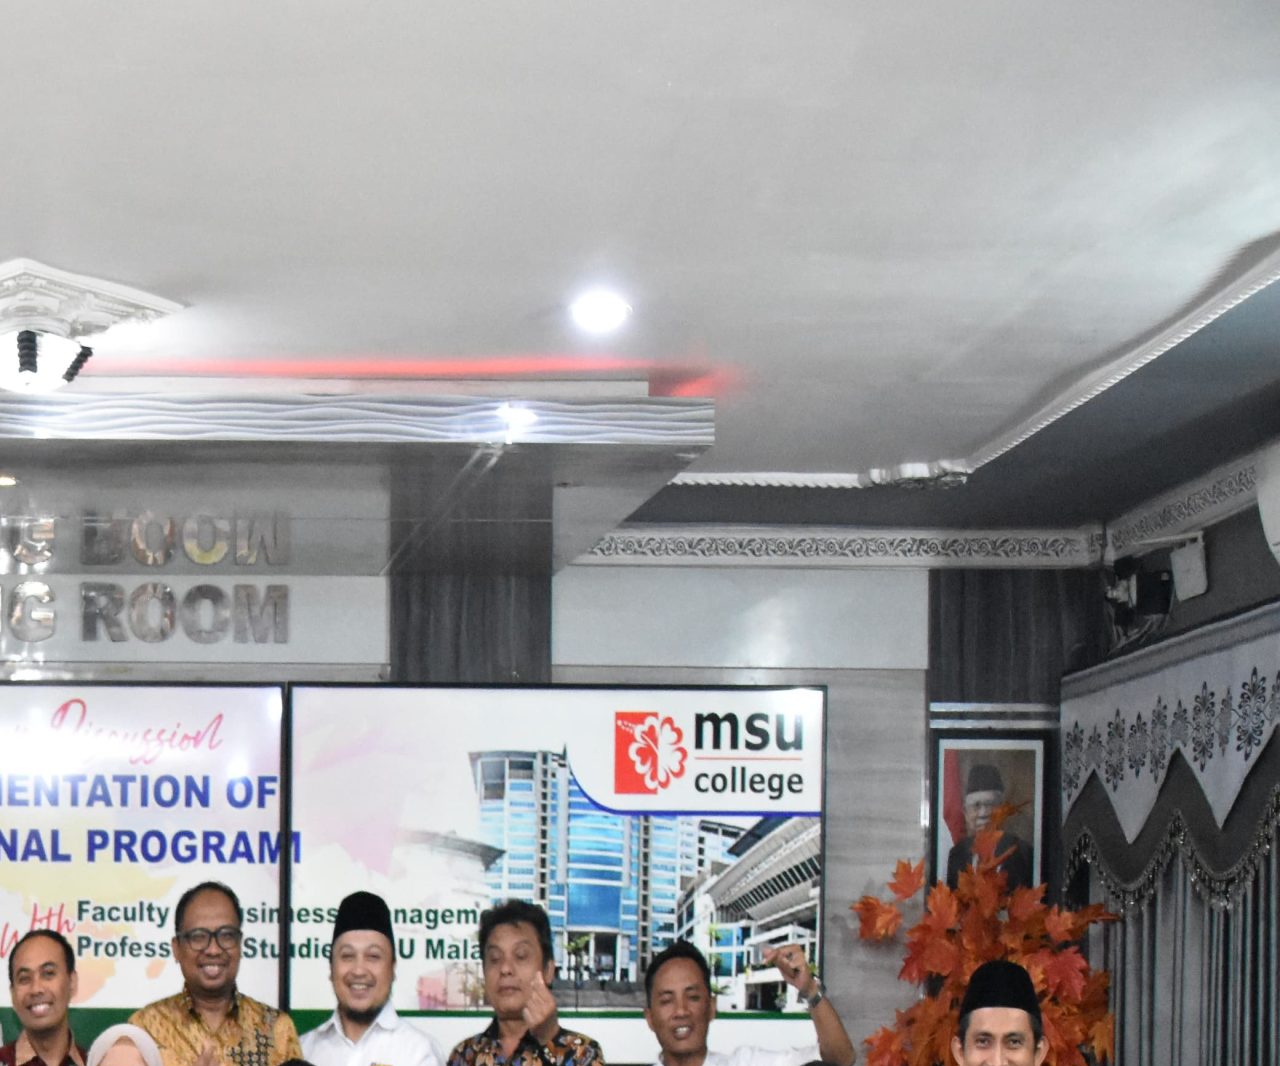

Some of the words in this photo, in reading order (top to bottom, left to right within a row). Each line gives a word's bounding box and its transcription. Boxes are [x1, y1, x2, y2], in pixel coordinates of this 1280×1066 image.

[80, 582, 289, 643] ROOM
[694, 711, 803, 751] msu
[226, 774, 280, 810] OF
[694, 766, 804, 800] college
[87, 829, 302, 865] PROGRAM
[77, 900, 170, 928] Faculty
[240, 902, 338, 925] siness
[77, 936, 170, 957] Profess
[243, 938, 333, 959] Studie
[425, 938, 485, 960] Mala
